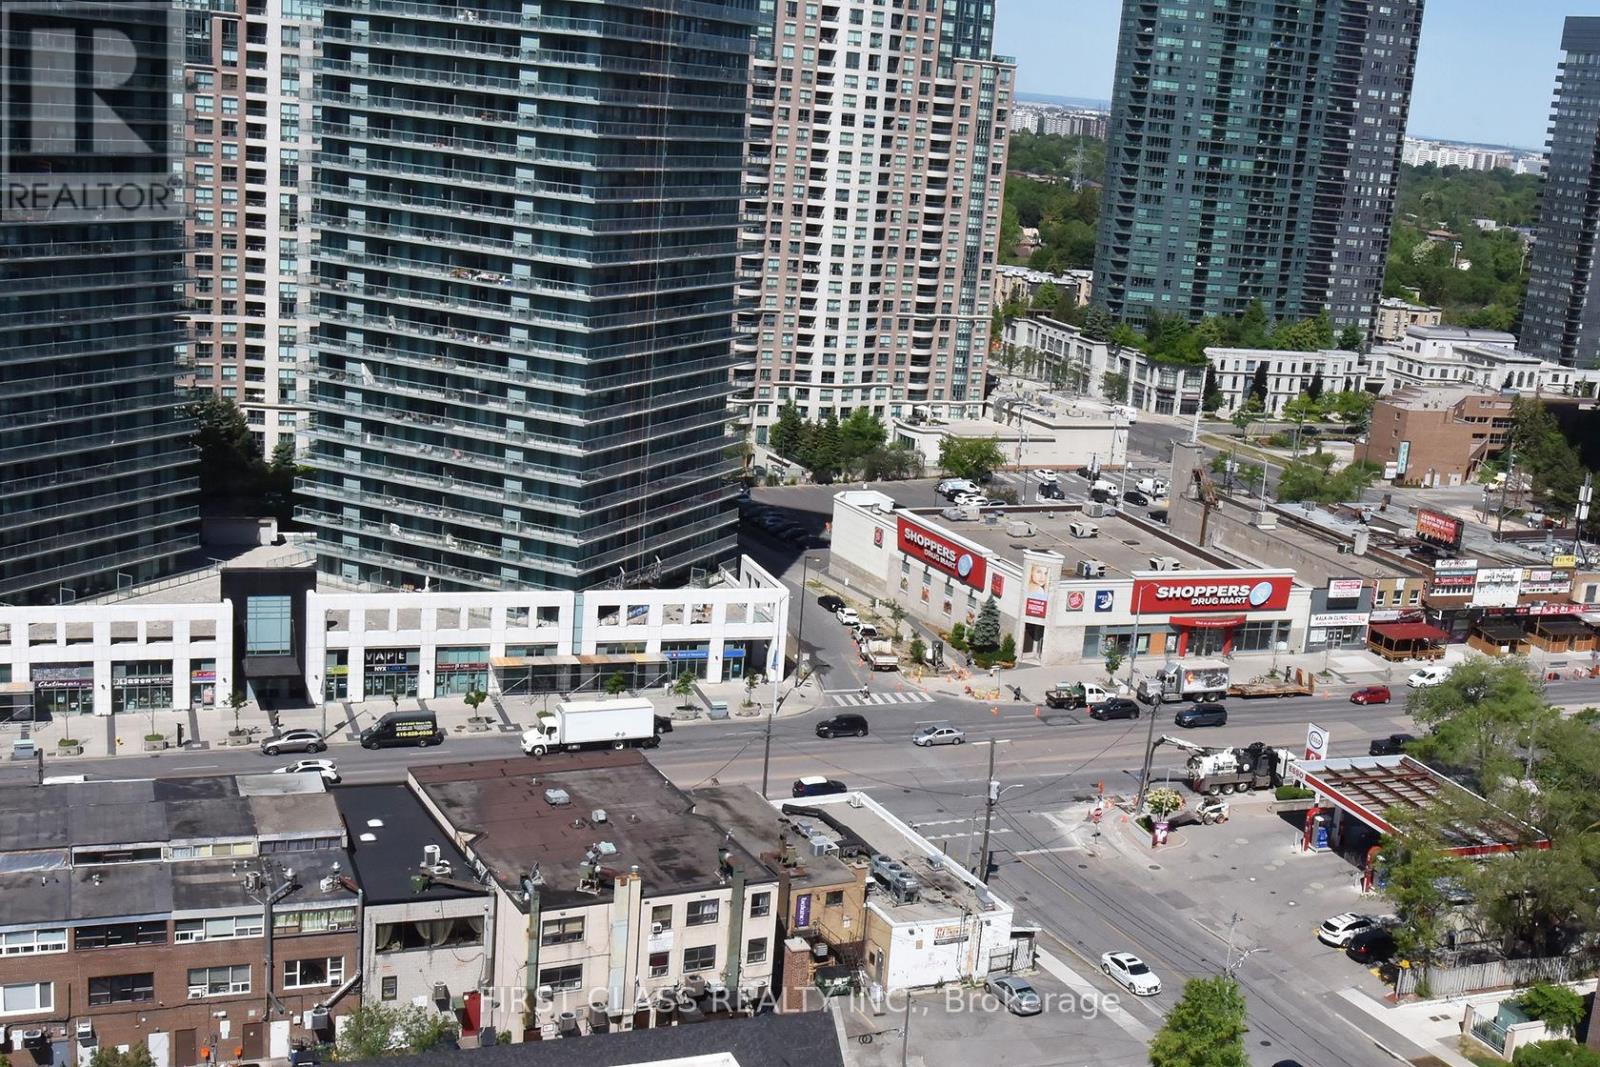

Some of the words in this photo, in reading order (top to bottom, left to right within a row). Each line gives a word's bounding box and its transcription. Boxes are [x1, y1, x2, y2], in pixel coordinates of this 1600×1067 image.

[904, 528, 957, 562] SHOPPERS
[1155, 585, 1251, 599] SHOPPERS
[1191, 597, 1219, 606] DRUG
[1220, 597, 1248, 605] MART
[366, 651, 405, 661] VAPE
